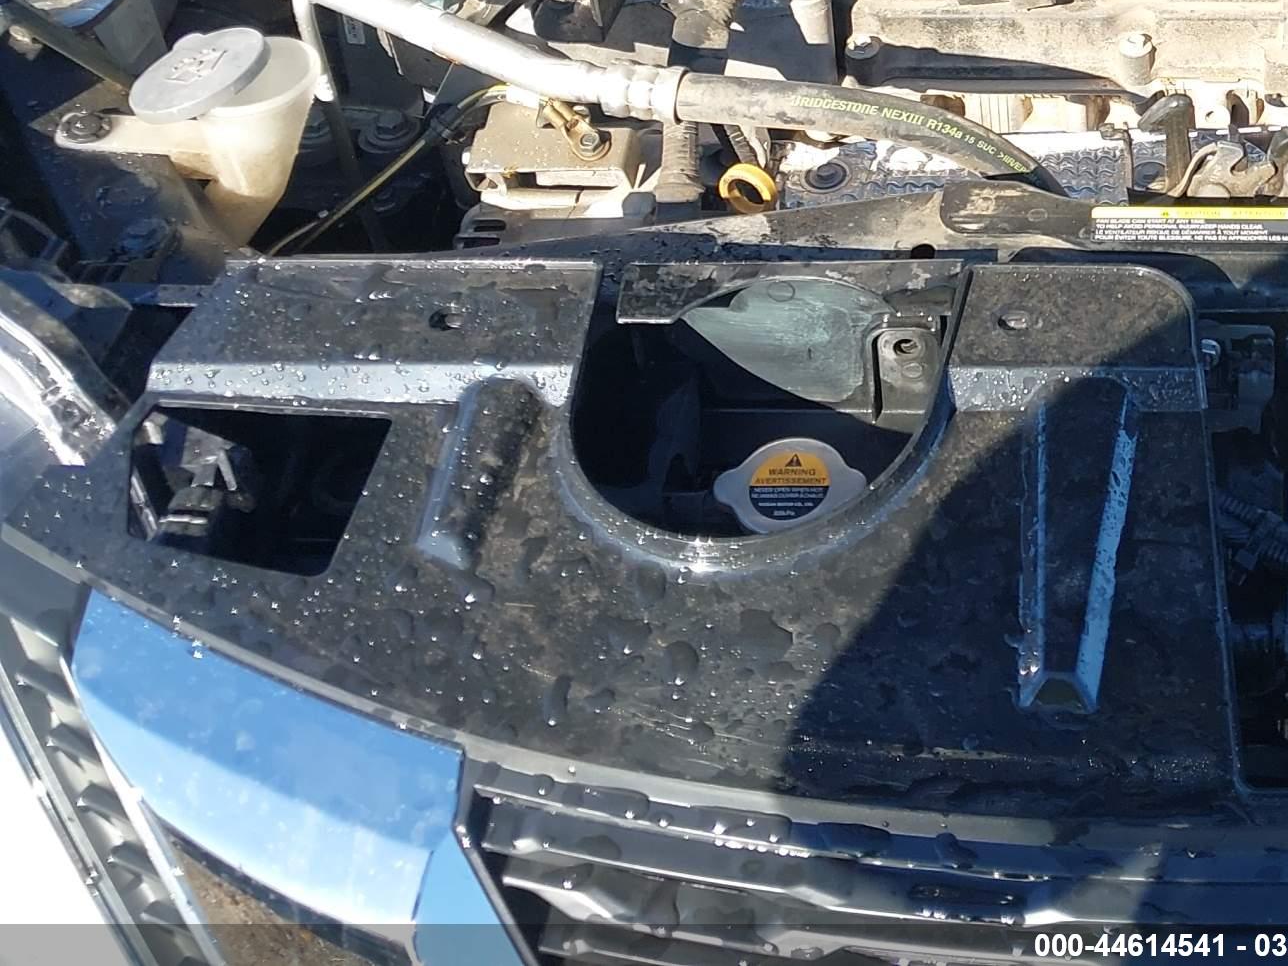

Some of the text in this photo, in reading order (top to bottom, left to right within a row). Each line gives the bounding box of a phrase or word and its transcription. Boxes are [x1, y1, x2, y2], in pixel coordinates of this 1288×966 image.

[791, 95, 879, 115] BRIDGESTONE
[881, 107, 925, 126] NEXIII
[926, 118, 963, 139] R134a
[964, 134, 975, 144] 15
[977, 140, 997, 155] SUC
[768, 468, 816, 476] WARNING
